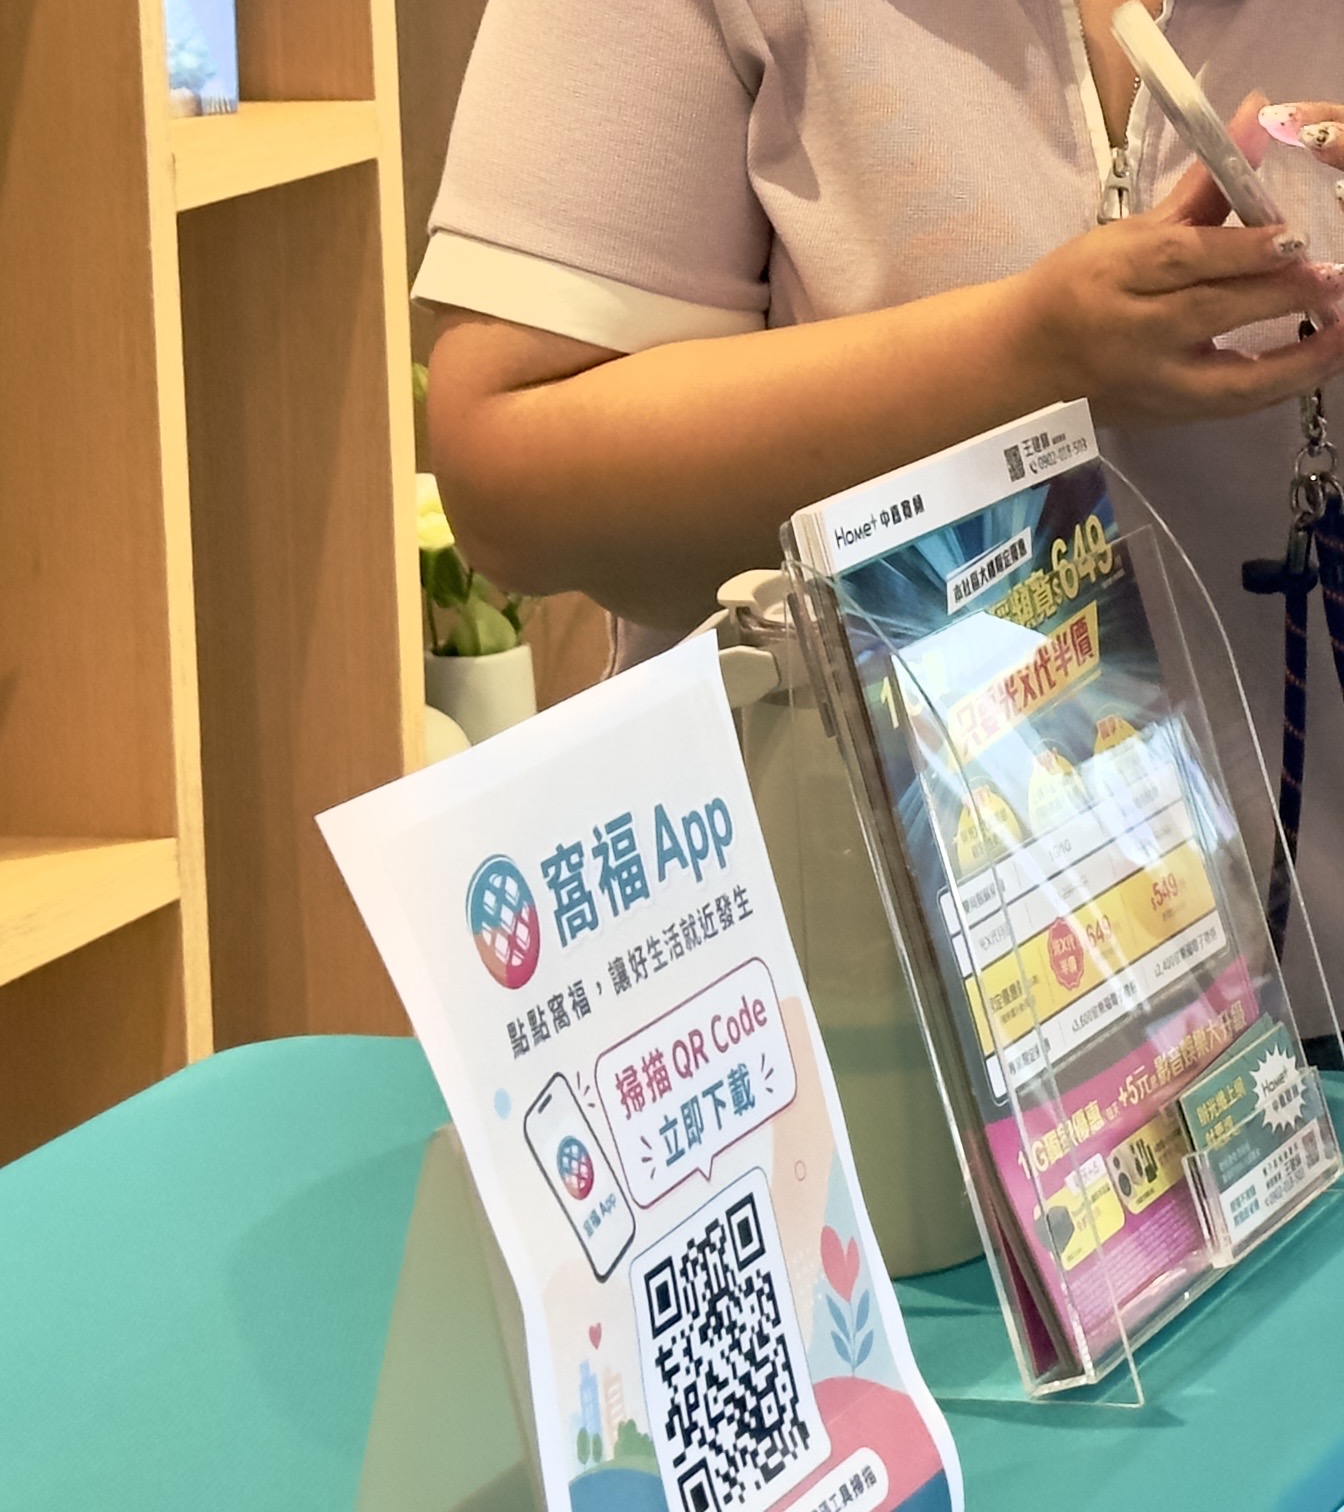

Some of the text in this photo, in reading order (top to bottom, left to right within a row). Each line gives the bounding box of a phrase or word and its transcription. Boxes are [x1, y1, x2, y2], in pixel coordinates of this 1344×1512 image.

[540, 796, 734, 948] 窩福 App
[506, 883, 755, 1061] 點點窩福，讓好生活就近發生
[614, 995, 768, 1120] 掃描 QR Code
[658, 1062, 757, 1168] 立即下載
